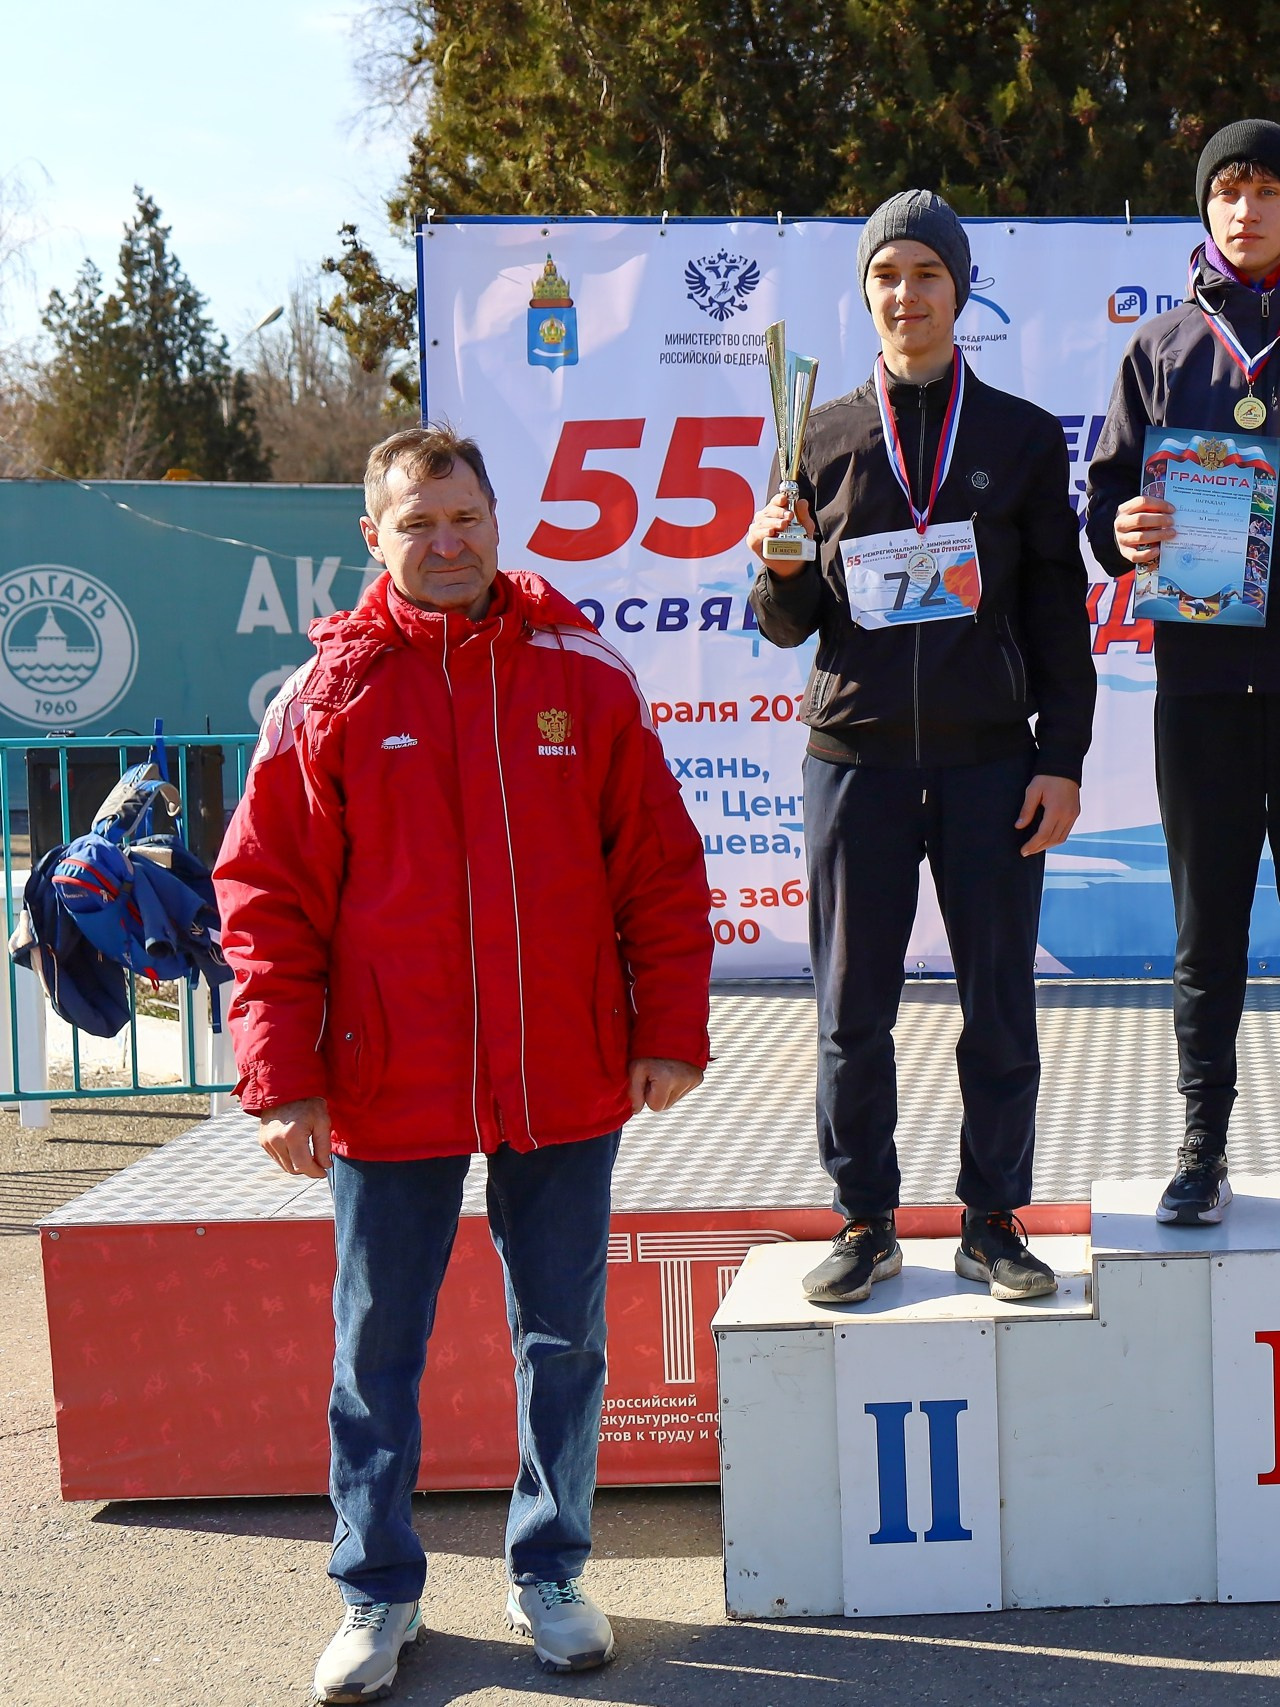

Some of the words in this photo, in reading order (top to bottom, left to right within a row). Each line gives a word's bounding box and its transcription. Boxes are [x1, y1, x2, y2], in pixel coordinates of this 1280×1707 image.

[665, 333, 740, 346] МИНИСТЕРСТВО
[960, 334, 1007, 343] ФЕДЕРАЦИЯ
[659, 350, 721, 365] РОССИЙСКОЙ
[526, 416, 765, 562] 55
[1170, 471, 1250, 489] ГРАМОТА
[846, 555, 861, 568] 55
[926, 539, 952, 548] ЗИМНИЙ
[884, 570, 946, 610] 72
[35, 699, 77, 715] 1960
[538, 745, 577, 756] RUSSIA
[664, 756, 770, 783] хань,
[739, 879, 809, 909] заб
[714, 919, 760, 945] 00
[636, 1431, 645, 1441] к
[649, 1429, 694, 1443] труду
[700, 1429, 709, 1439] и
[864, 1399, 973, 1545] II
